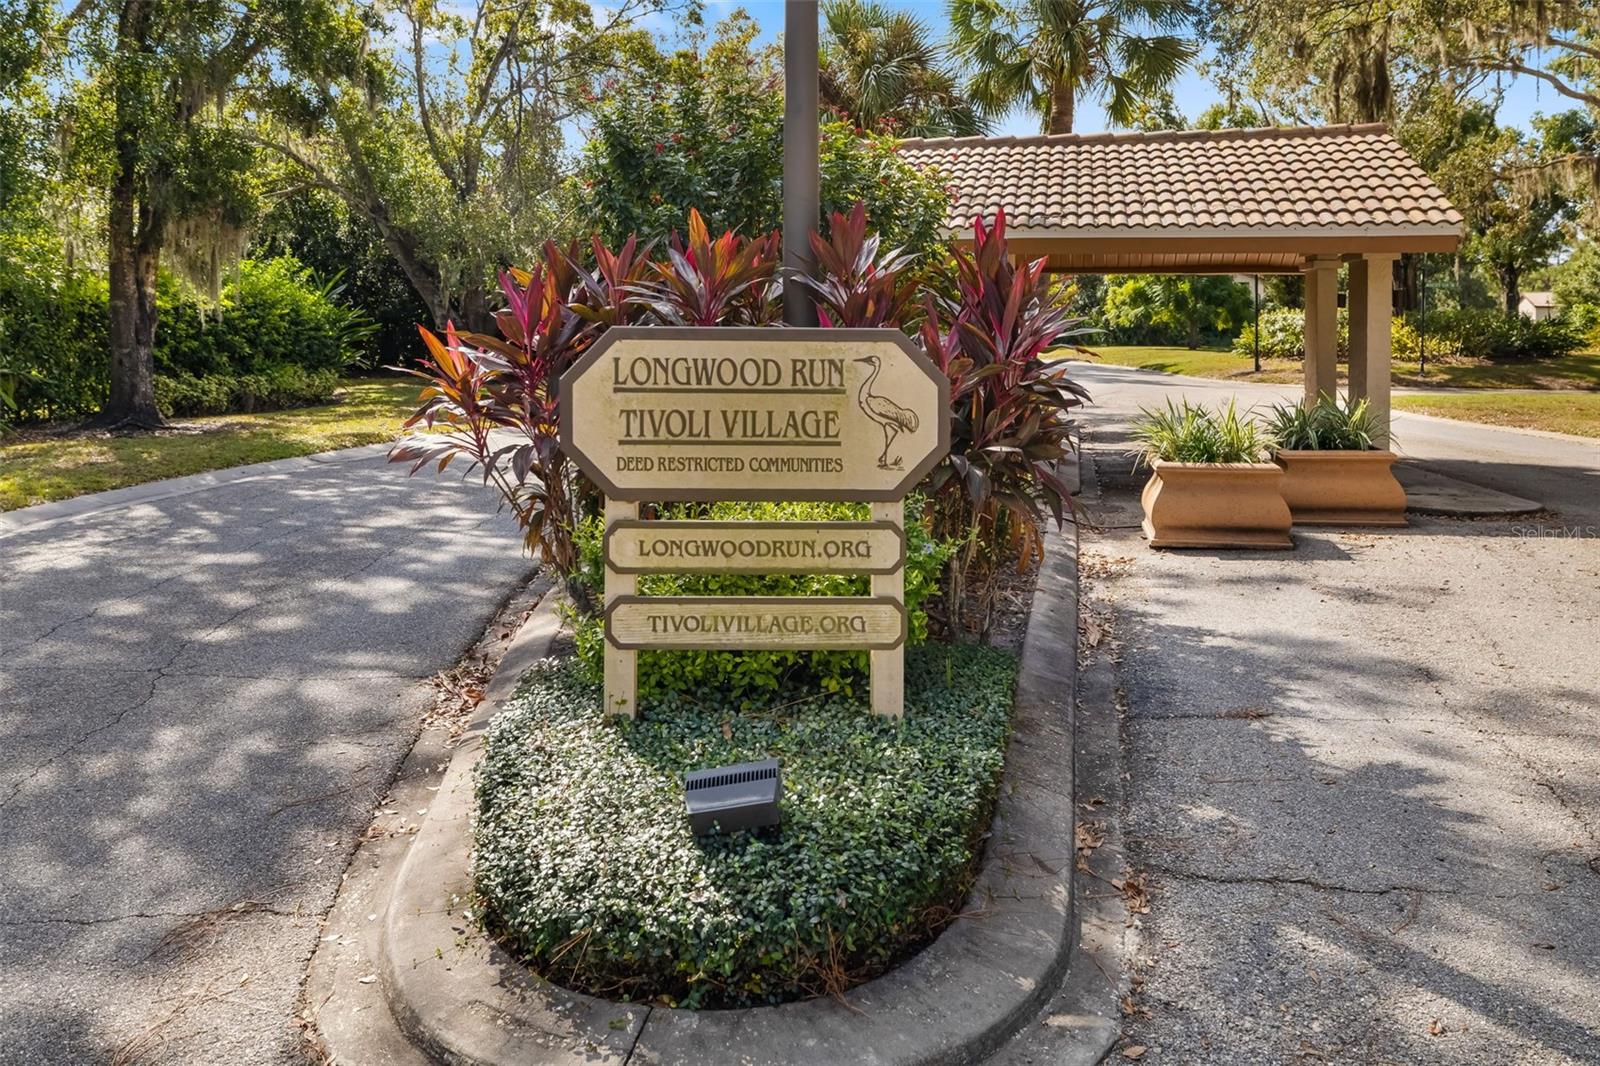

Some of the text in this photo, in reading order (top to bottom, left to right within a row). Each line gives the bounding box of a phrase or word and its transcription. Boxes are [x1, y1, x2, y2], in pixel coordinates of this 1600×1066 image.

[613, 357, 845, 387] LONGWOOD RUN
[618, 409, 841, 439] TIVOLI VILLAGE
[616, 456, 843, 473] DEED RESTRICTED COMMUNITIES
[638, 538, 872, 559] LONGWOODRUN.ORG
[647, 615, 867, 634] TIVOLIVILLAGE.ORG
